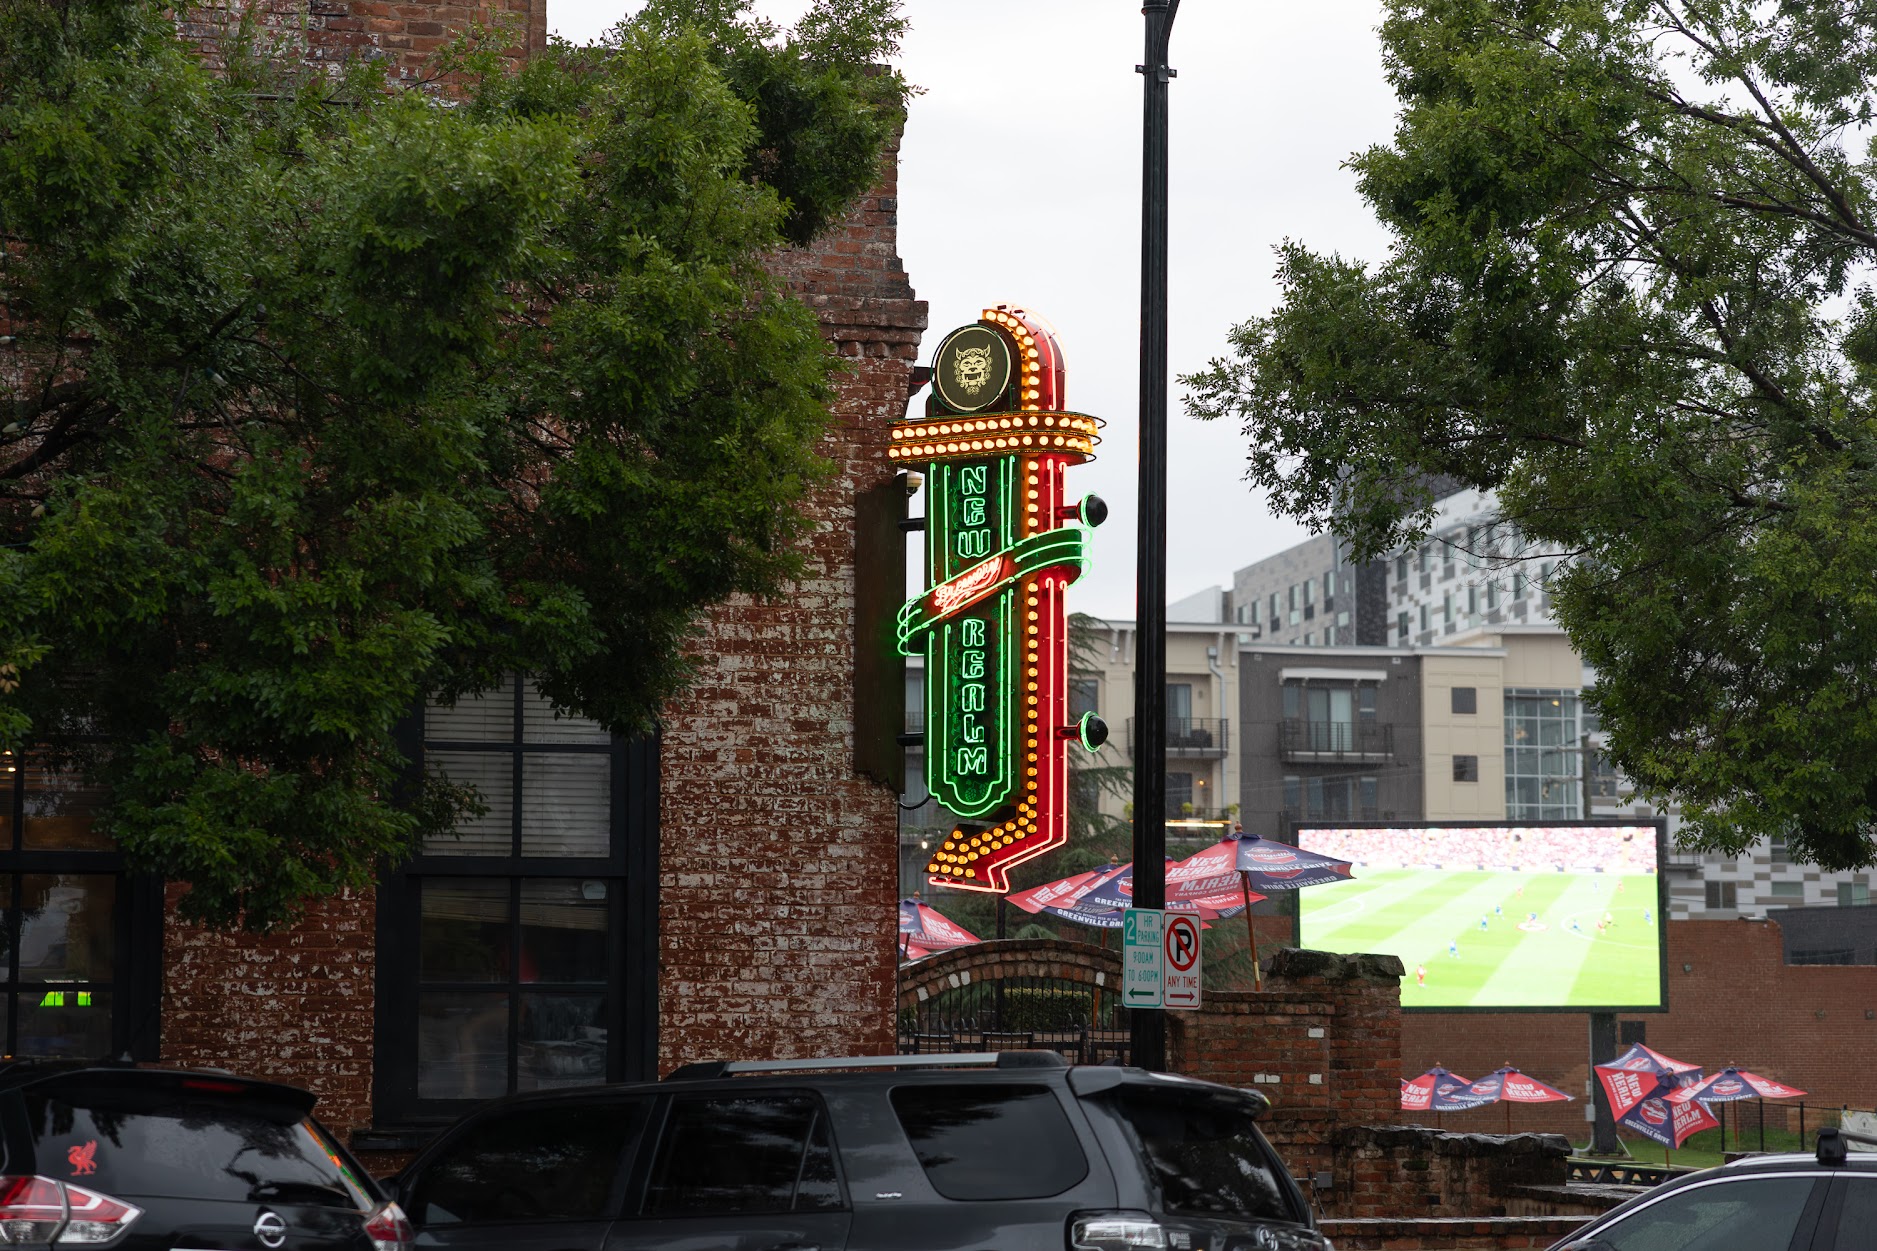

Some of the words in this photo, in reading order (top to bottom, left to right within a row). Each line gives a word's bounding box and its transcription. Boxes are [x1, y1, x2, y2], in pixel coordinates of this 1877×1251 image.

[957, 465, 991, 559] NEW
[957, 618, 987, 776] REALM
[1185, 853, 1230, 868] NEW
[1165, 861, 1229, 878] REALM
[1094, 897, 1133, 909] GREENV
[1057, 908, 1108, 927] GREENVILLE
[1109, 919, 1124, 927] DRI
[1143, 915, 1153, 928] HR
[1126, 916, 1135, 940] 2
[1137, 930, 1160, 943] PARKING
[1133, 951, 1154, 965] 9:00AM
[1128, 969, 1135, 981] TO
[1139, 970, 1159, 982] 6:00PM
[1167, 976, 1181, 988] ANY
[1183, 976, 1198, 989] TIME
[1405, 1083, 1431, 1095] NEW
[1507, 1081, 1535, 1091] NEW
[1625, 1072, 1643, 1098] NEW
[1505, 1087, 1546, 1098] REALM
[1624, 1118, 1653, 1137] GREENVILLE
[1653, 1130, 1671, 1144] DRIVE
